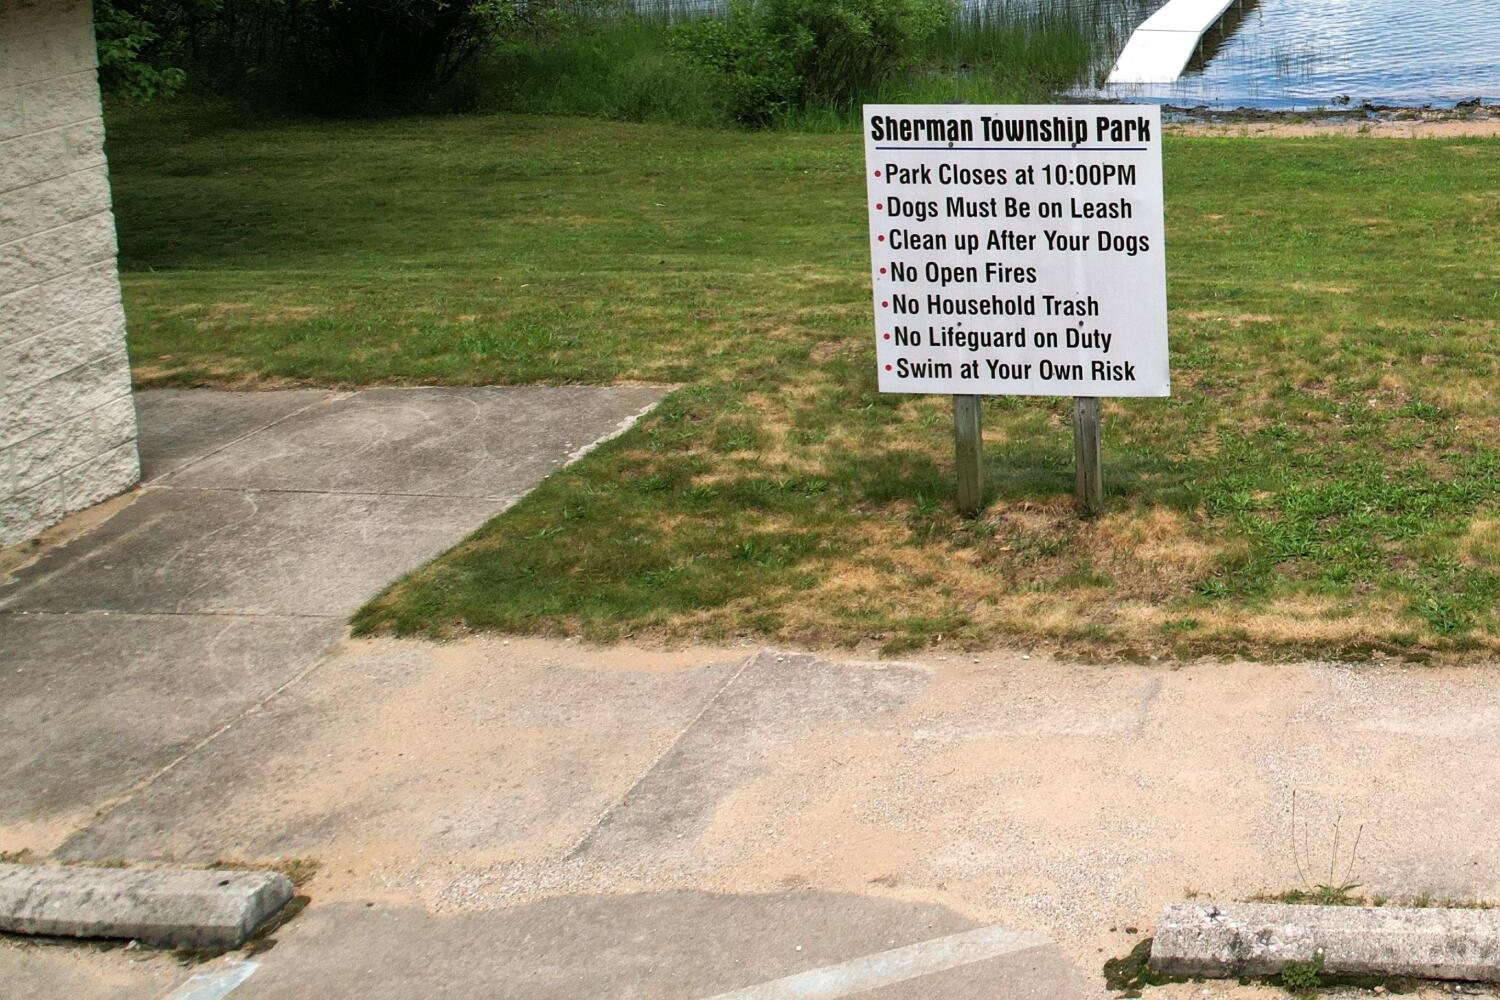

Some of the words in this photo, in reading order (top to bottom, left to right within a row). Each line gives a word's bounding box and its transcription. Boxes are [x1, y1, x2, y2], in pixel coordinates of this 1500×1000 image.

[871, 116, 973, 141] Sherman
[981, 117, 1087, 144] Township
[1097, 117, 1150, 142] Park
[886, 164, 931, 184] Park
[939, 164, 1007, 185] Closes
[1016, 165, 1034, 185] at
[1042, 165, 1135, 185] 10:00PM
[888, 197, 938, 222] Dogs
[947, 197, 997, 217] Must
[1005, 197, 1030, 218] Be
[1039, 202, 1062, 218] on
[1071, 198, 1131, 218] Leash
[890, 229, 946, 250] Clean
[955, 235, 978, 255] up
[987, 230, 1036, 250] After
[1044, 230, 1089, 251] Your
[1098, 231, 1149, 256] Dogs
[891, 262, 917, 282] No
[926, 262, 977, 287] Open
[986, 263, 1036, 283] Fires
[893, 294, 919, 314] No
[928, 295, 1035, 315] Household
[1042, 296, 1098, 316] Trash
[895, 326, 921, 346] No
[929, 327, 1025, 351] Lifeguard
[1034, 332, 1057, 348] on
[1066, 328, 1111, 353] Duty
[897, 358, 952, 378] Swim
[961, 360, 979, 379] at
[986, 359, 1031, 379] Your
[1040, 360, 1083, 380] Own
[1092, 361, 1135, 381] Risk
